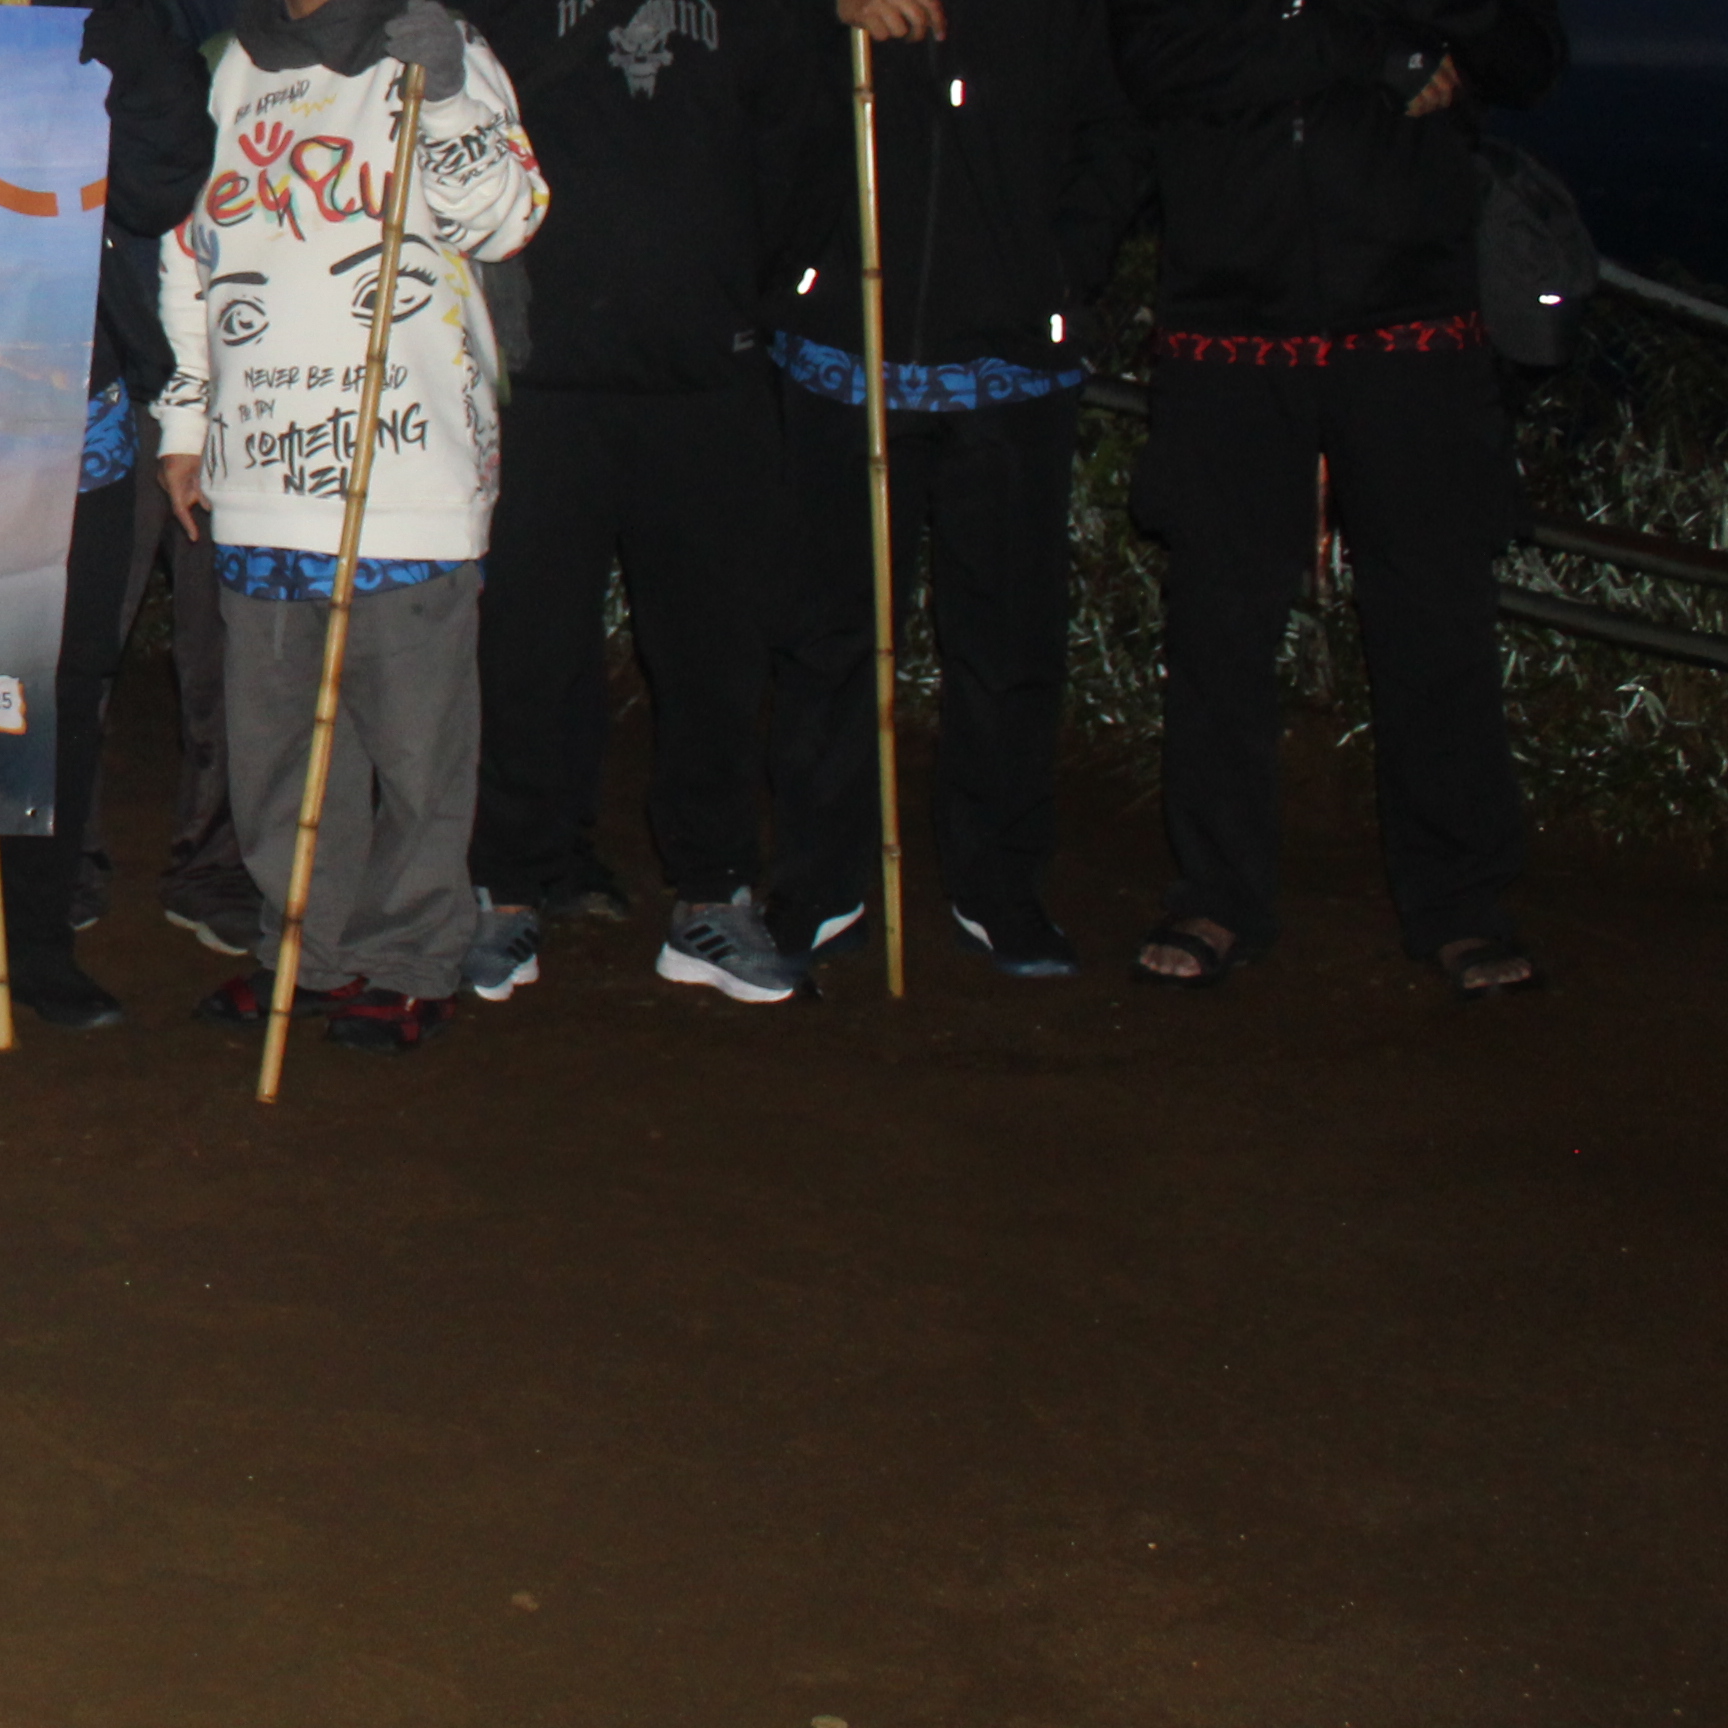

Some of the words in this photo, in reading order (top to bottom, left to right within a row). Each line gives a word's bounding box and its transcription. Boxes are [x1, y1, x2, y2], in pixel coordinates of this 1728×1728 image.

[244, 366, 300, 393] NEVER
[306, 365, 335, 390] BE
[244, 402, 430, 475] SOMETHNG
